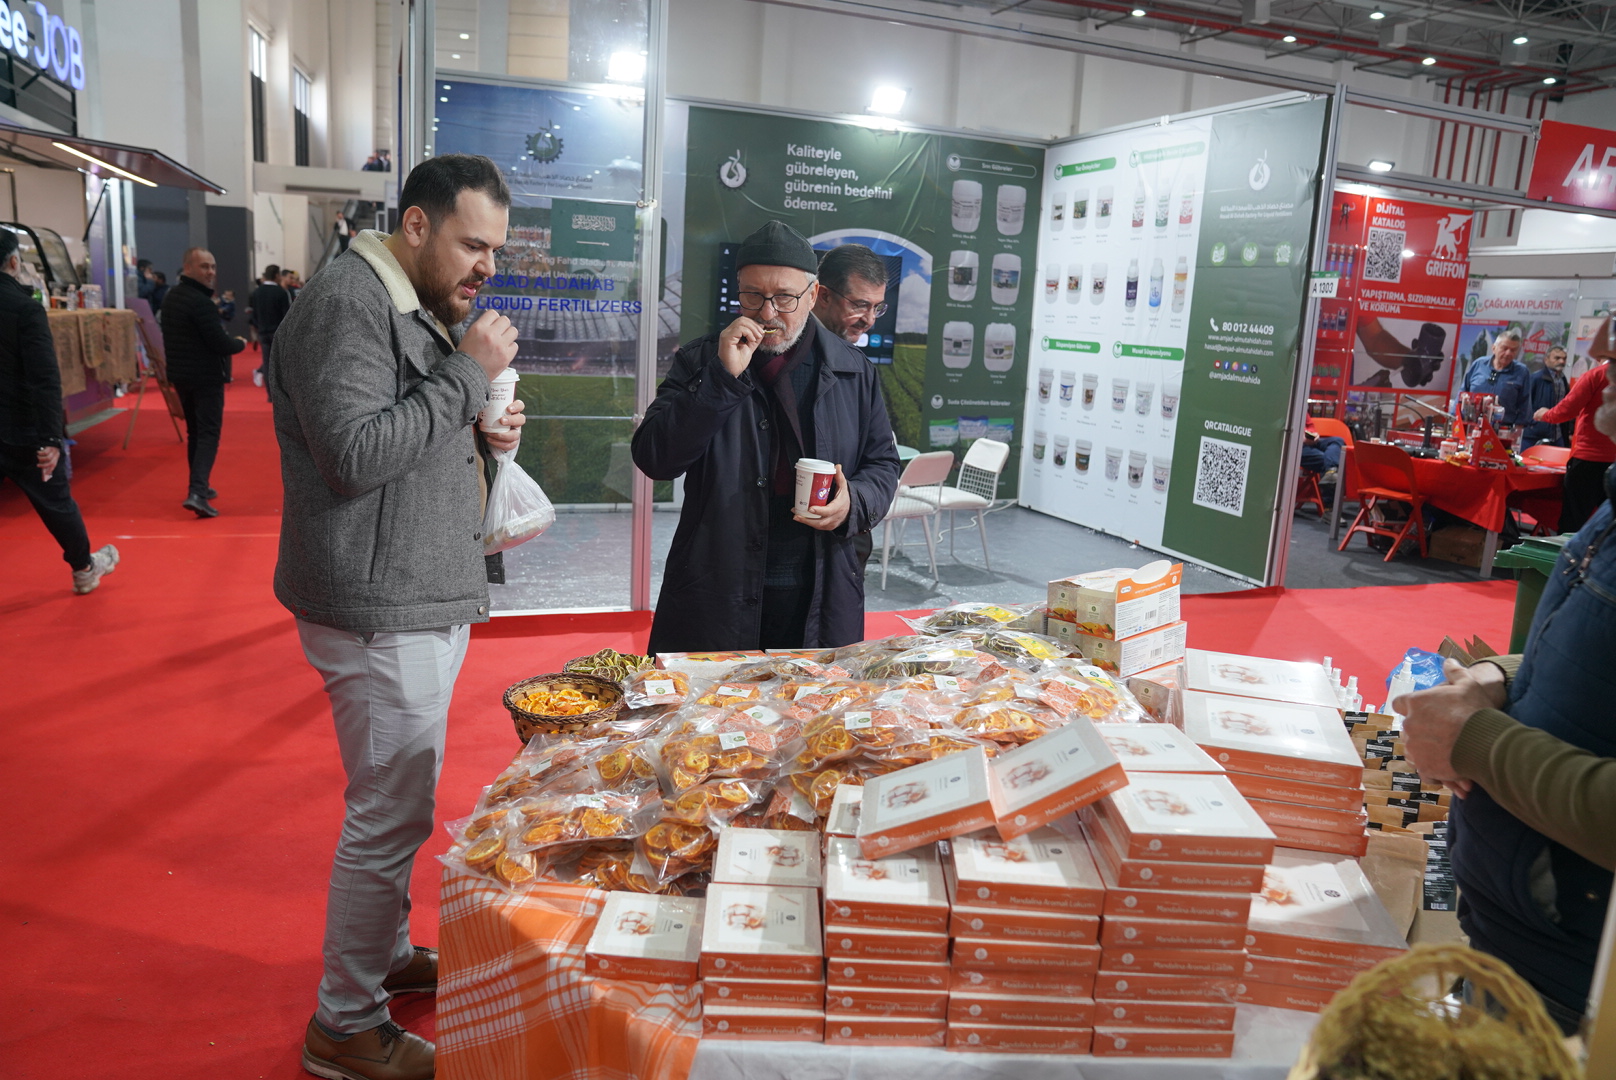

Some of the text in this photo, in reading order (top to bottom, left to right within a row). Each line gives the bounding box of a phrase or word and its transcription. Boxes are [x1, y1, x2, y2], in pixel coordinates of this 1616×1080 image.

[34, 1, 85, 91] JOB
[786, 144, 842, 162] Kaliteyle
[786, 162, 858, 181] gübreleyen,
[784, 180, 892, 200] gübrenin bedelini
[784, 196, 838, 212] ödemez.
[1376, 202, 1404, 216] DİJİTAL
[1372, 216, 1405, 229] KATALOG
[1426, 260, 1466, 280] GRIFFON
[534, 276, 615, 291] ALDAHAB
[1312, 282, 1334, 294] A 1303
[476, 296, 642, 314] LIQIUD FERTILIZERS
[1361, 289, 1456, 306] YAPIŞTIRMA, SIZDIRMAZLIK
[1484, 298, 1564, 310] ÇAĞLAYAN PLASTİK
[1359, 302, 1401, 314] VE KORUMA
[1222, 322, 1274, 335] 80 012 44409
[1204, 420, 1252, 437] QRCATALOGUE
[1045, 800, 1074, 816] Mandalina
[908, 827, 939, 842] Mandalina
[1010, 896, 1042, 905] Mandalina
